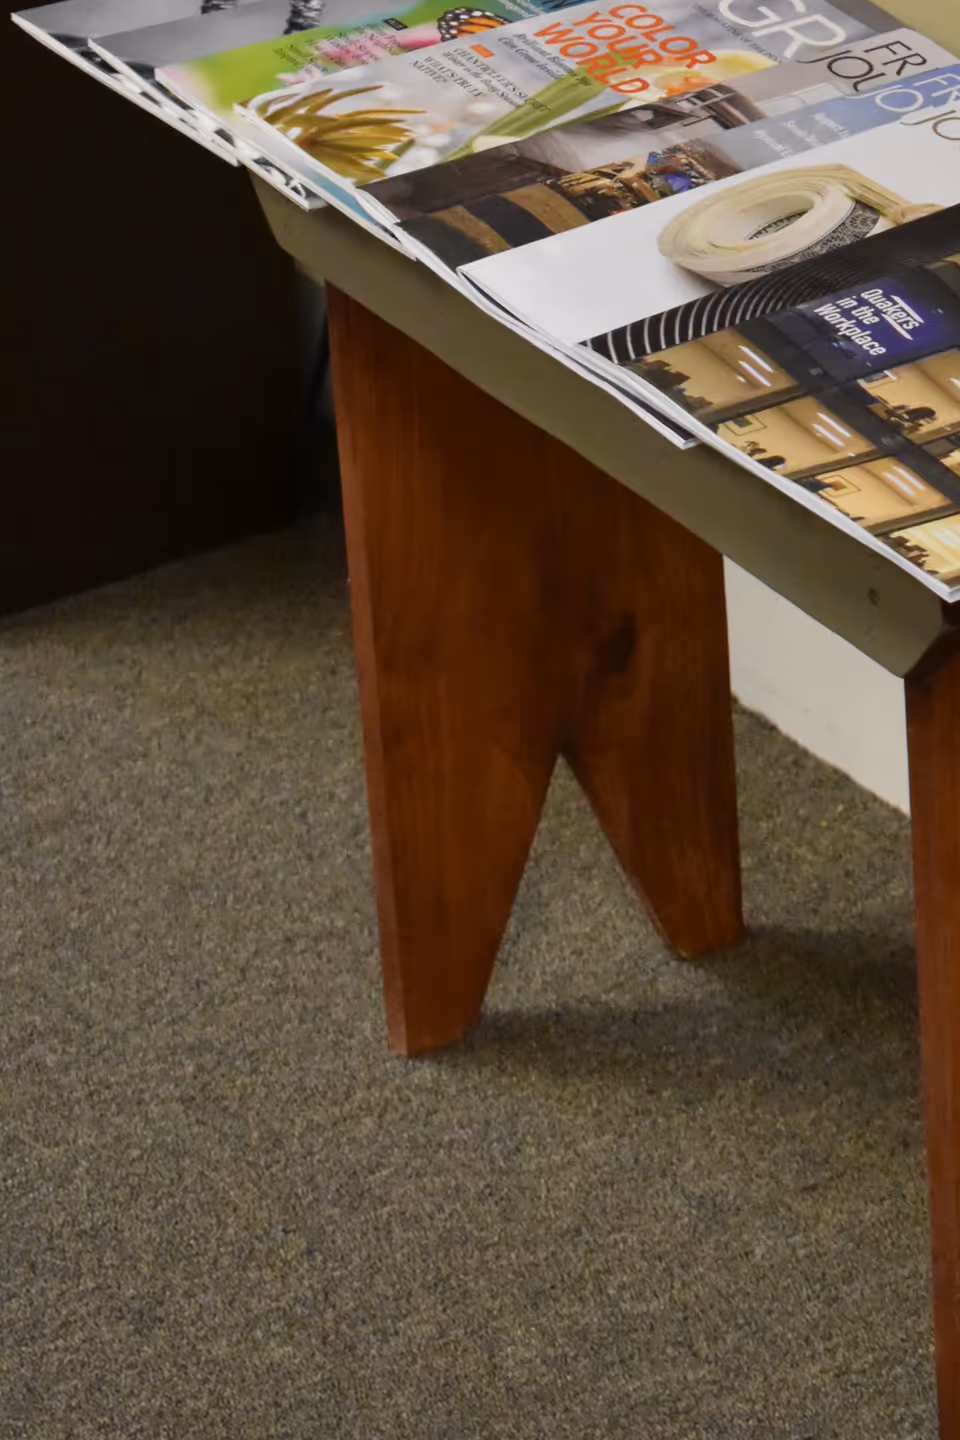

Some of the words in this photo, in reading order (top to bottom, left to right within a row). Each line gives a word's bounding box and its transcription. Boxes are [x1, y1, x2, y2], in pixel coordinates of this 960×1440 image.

[533, 22, 650, 94] WORLD
[572, 11, 664, 70] YOUR
[608, 4, 716, 69] COLOR
[864, 40, 927, 76] FR
[813, 303, 887, 356] Workplace
[836, 295, 858, 309] in
[851, 305, 880, 325] the
[861, 288, 920, 330] Quakers
